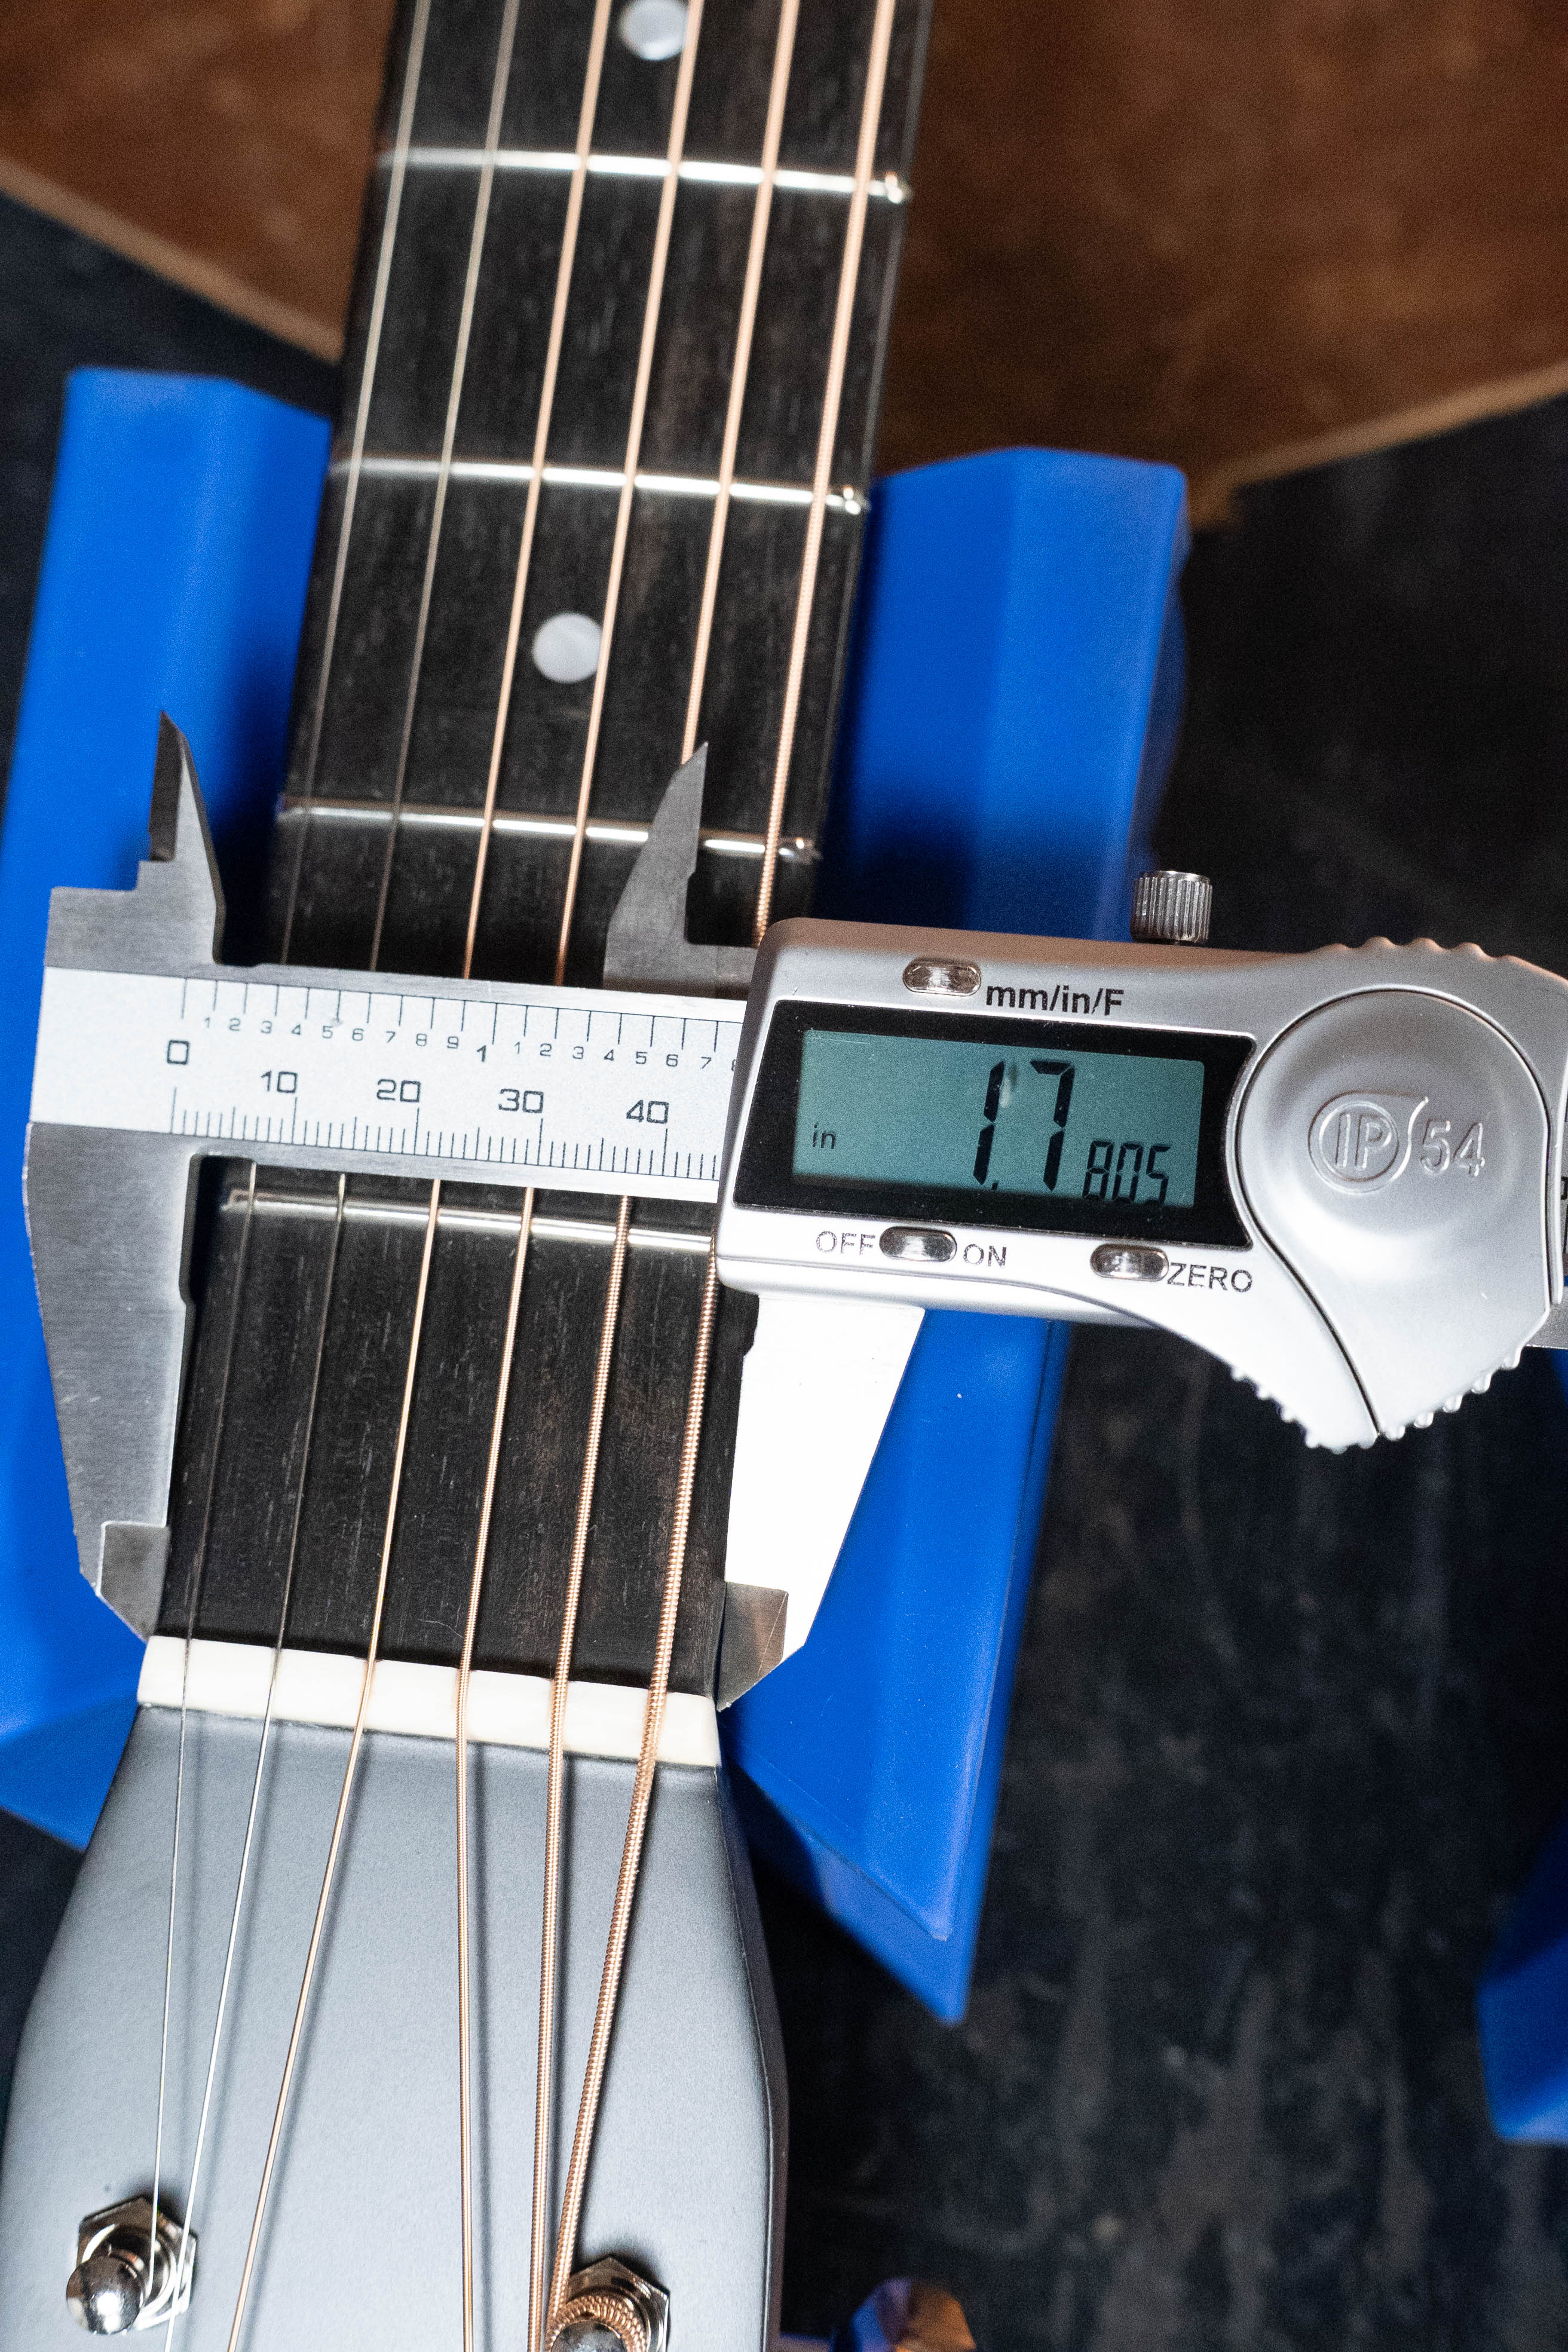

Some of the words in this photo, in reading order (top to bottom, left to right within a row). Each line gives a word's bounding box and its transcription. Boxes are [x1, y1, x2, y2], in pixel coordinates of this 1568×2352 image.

[986, 985, 1124, 1016] mm/in/F
[204, 1017, 211, 1028] 1
[229, 1018, 241, 1031] 2
[260, 1021, 272, 1034] 3
[291, 1024, 302, 1036] 4
[321, 1025, 333, 1039] 5
[352, 1028, 364, 1042] 6
[385, 1031, 396, 1043] 7
[415, 1033, 427, 1047] 8
[447, 1036, 459, 1049] 9
[477, 1045, 487, 1062] 1
[514, 1042, 521, 1054] 1
[539, 1043, 552, 1057] 2
[572, 1046, 584, 1059] 3
[604, 1049, 615, 1062] 4
[635, 1051, 648, 1065] 5
[666, 1054, 679, 1067] 6
[700, 1056, 712, 1070] 7
[167, 1040, 189, 1065] 0
[261, 1070, 298, 1094] 10
[376, 1078, 421, 1103] 20
[498, 1088, 544, 1114] 30
[626, 1099, 669, 1124] 40
[811, 1125, 836, 1149] in
[1335, 1111, 1392, 1169] IP
[1419, 1118, 1486, 1177] 54
[816, 1230, 876, 1255] OFF
[963, 1244, 1006, 1267] ON
[1167, 1263, 1252, 1293] ZERO
